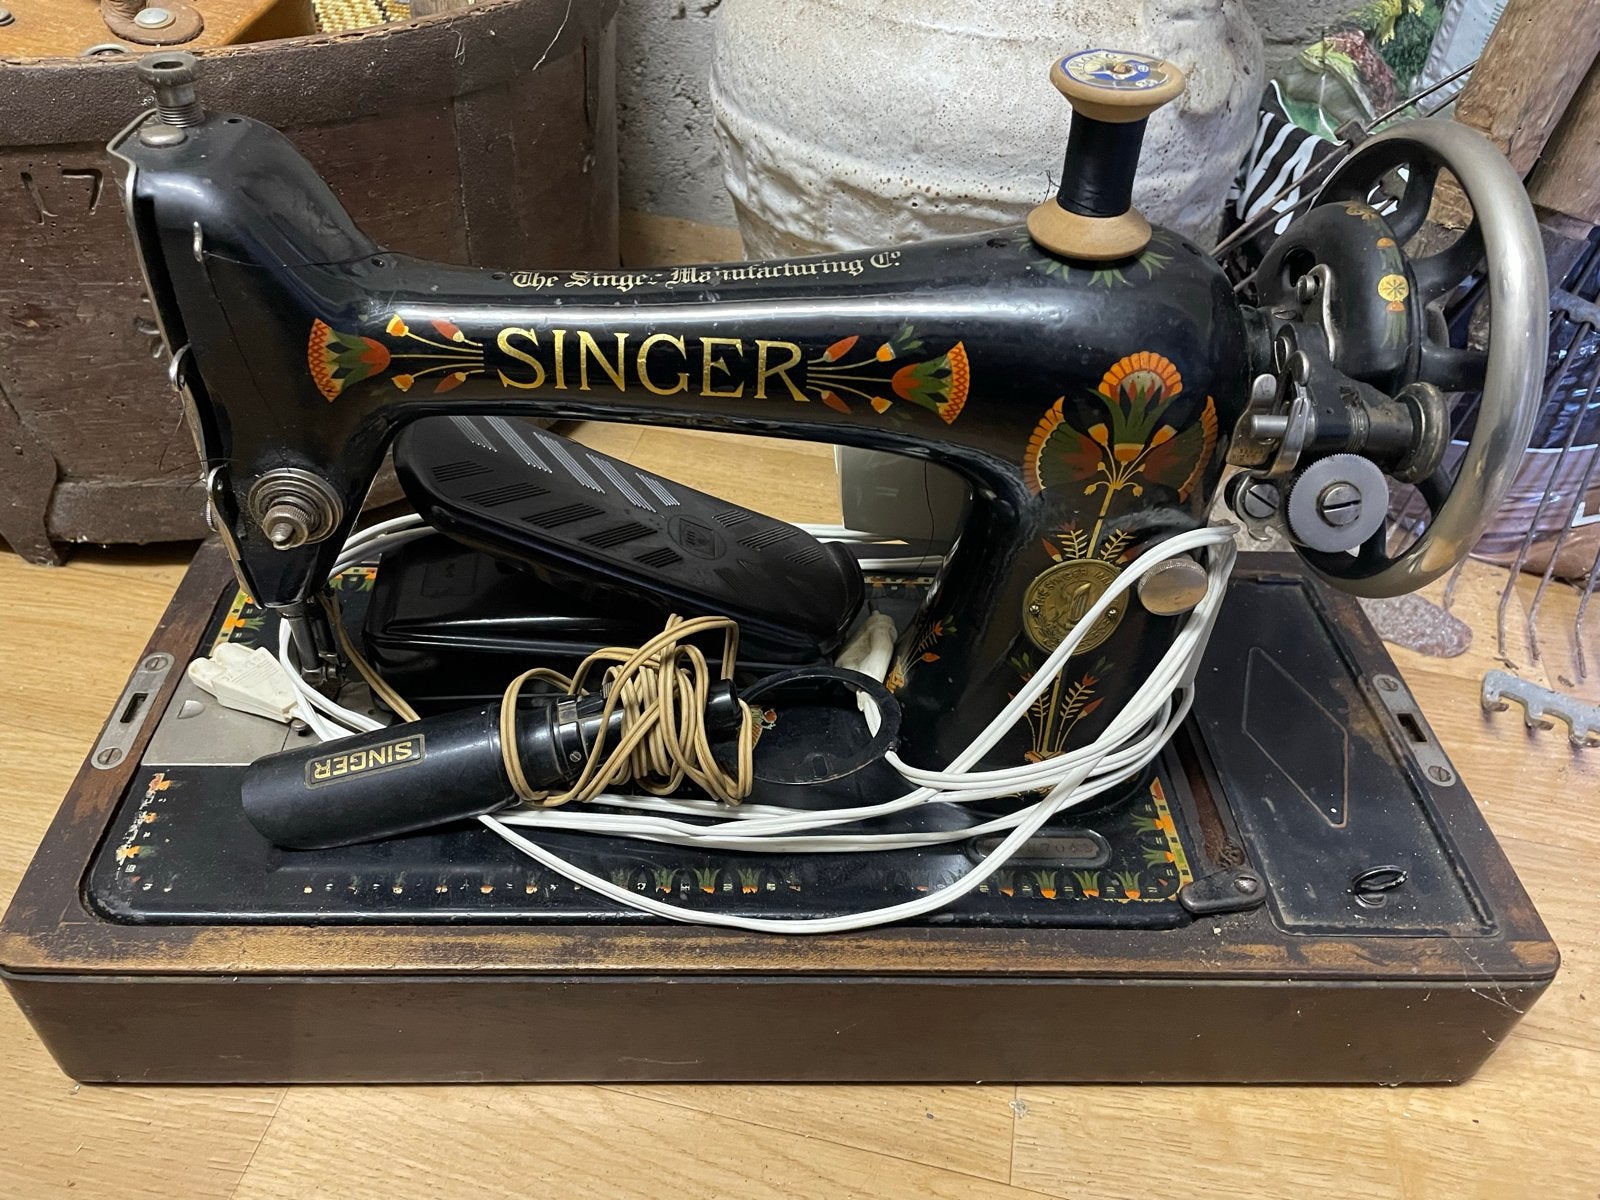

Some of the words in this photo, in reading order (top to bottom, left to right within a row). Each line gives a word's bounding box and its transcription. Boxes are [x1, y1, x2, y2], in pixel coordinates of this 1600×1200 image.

[511, 271, 559, 291] The
[496, 327, 810, 402] SINGER
[314, 741, 412, 779] SINGER
